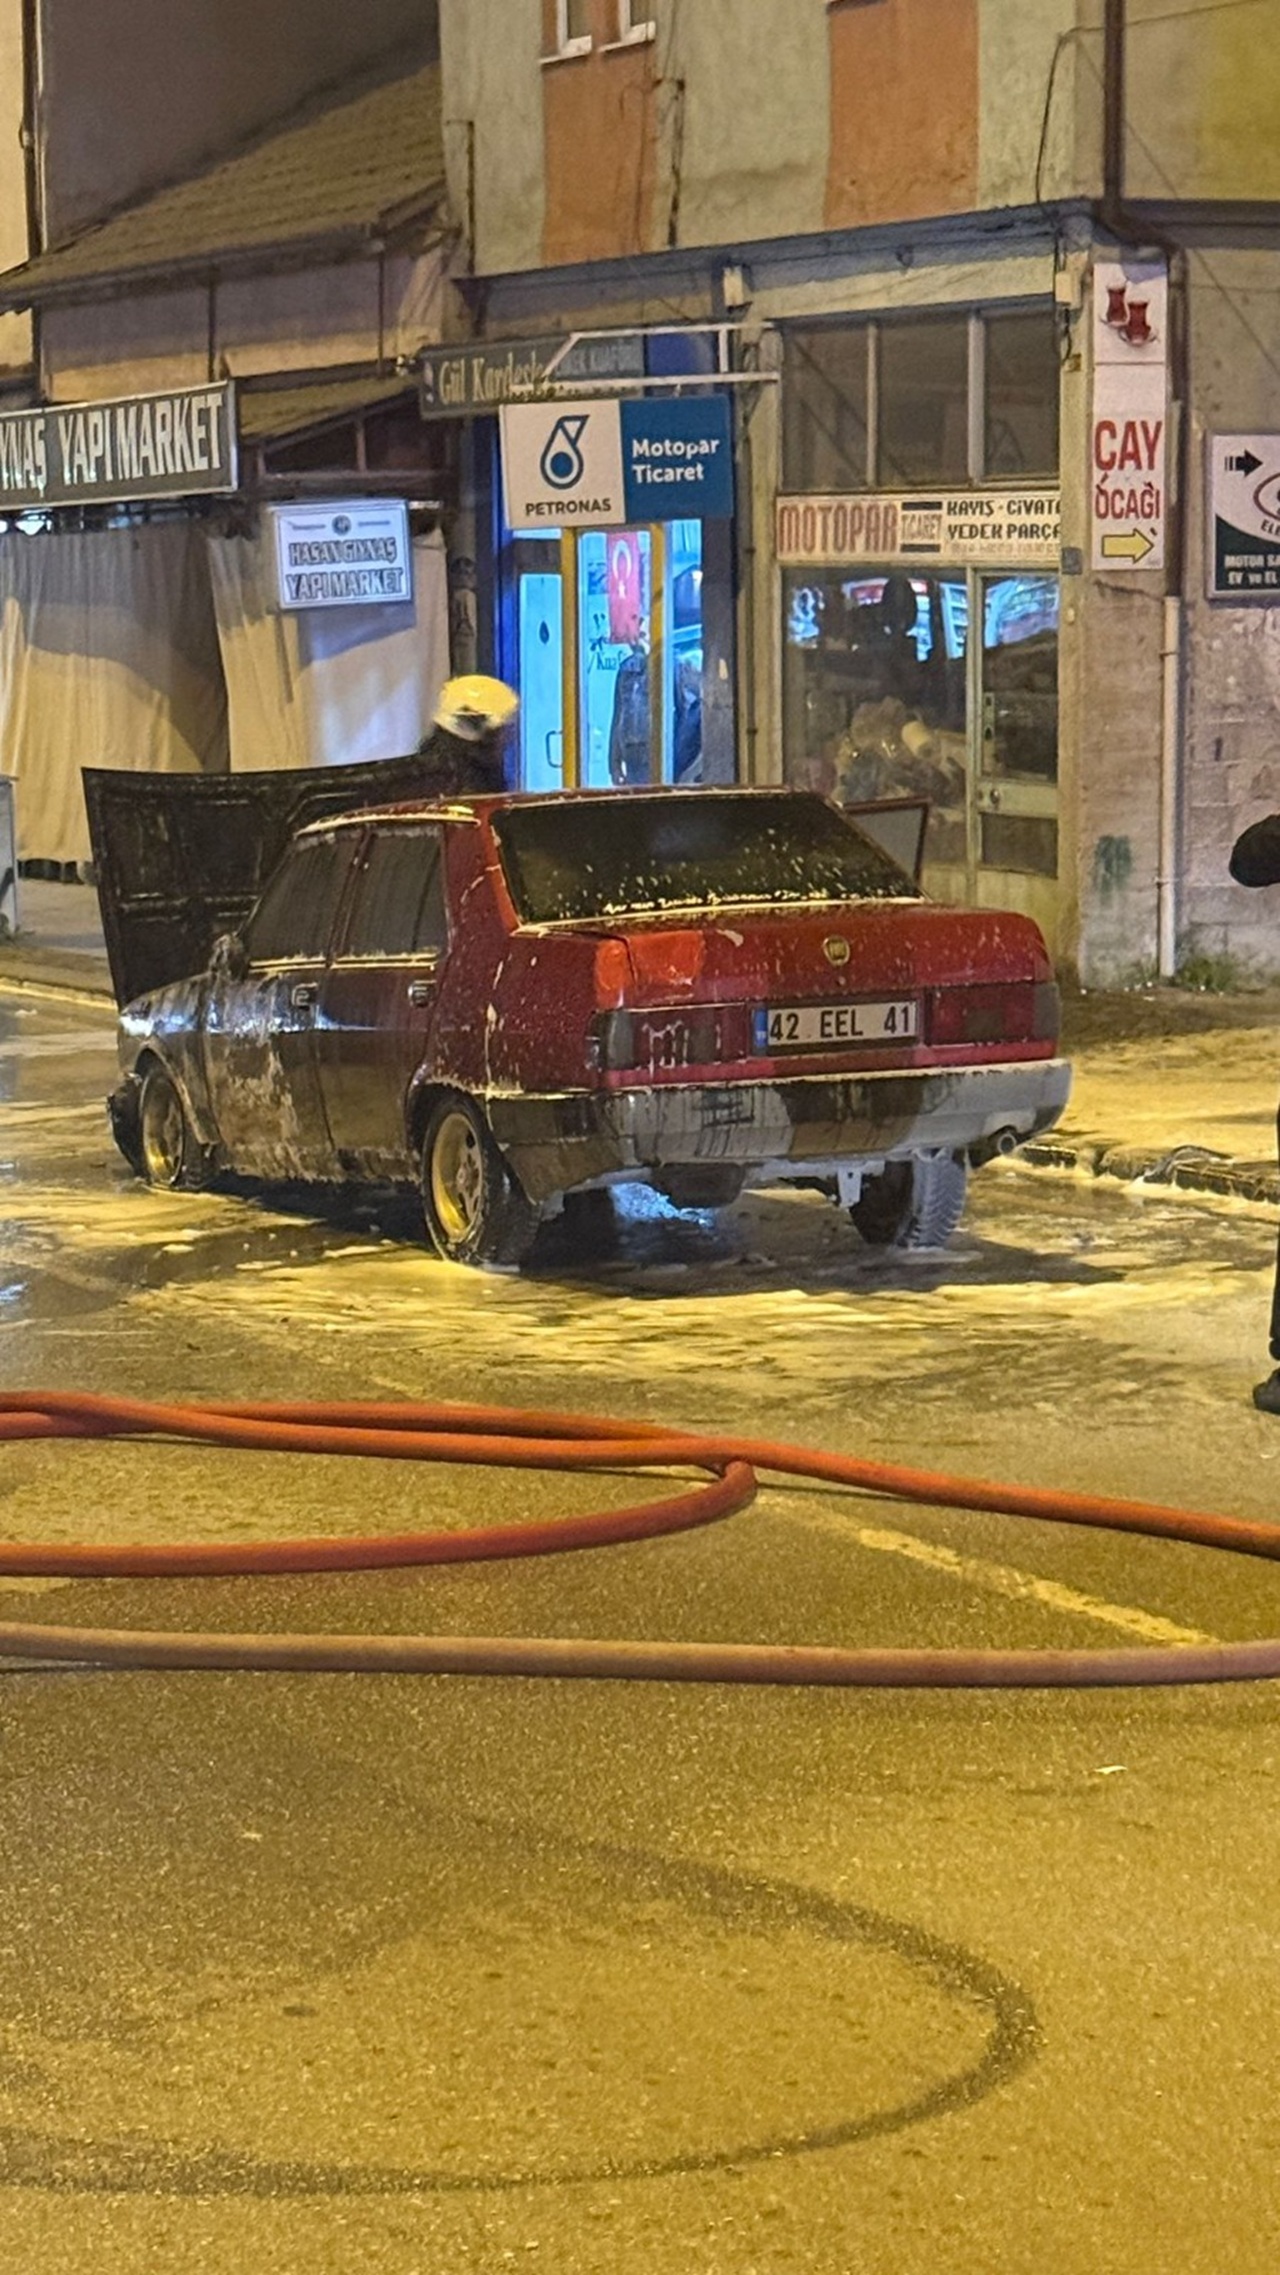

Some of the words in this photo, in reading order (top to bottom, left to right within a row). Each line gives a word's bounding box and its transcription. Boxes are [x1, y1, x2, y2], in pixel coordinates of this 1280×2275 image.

[438, 358, 466, 405] Gül
[58, 409, 113, 486] YAPI
[116, 392, 223, 480] MARKET
[632, 437, 720, 461] Motopar
[632, 463, 705, 484] Ticaret
[525, 498, 611, 517] PETRONAS
[947, 499, 990, 517] KAYIŞ
[780, 503, 898, 553] MOTOPAR
[948, 523, 1002, 540] YEDEK
[289, 540, 341, 566] HASAN
[285, 572, 329, 600] YAPI
[330, 567, 404, 598] MARKET
[769, 1012, 799, 1041] 42
[820, 1009, 863, 1038] EEL
[884, 1005, 909, 1034] 41
